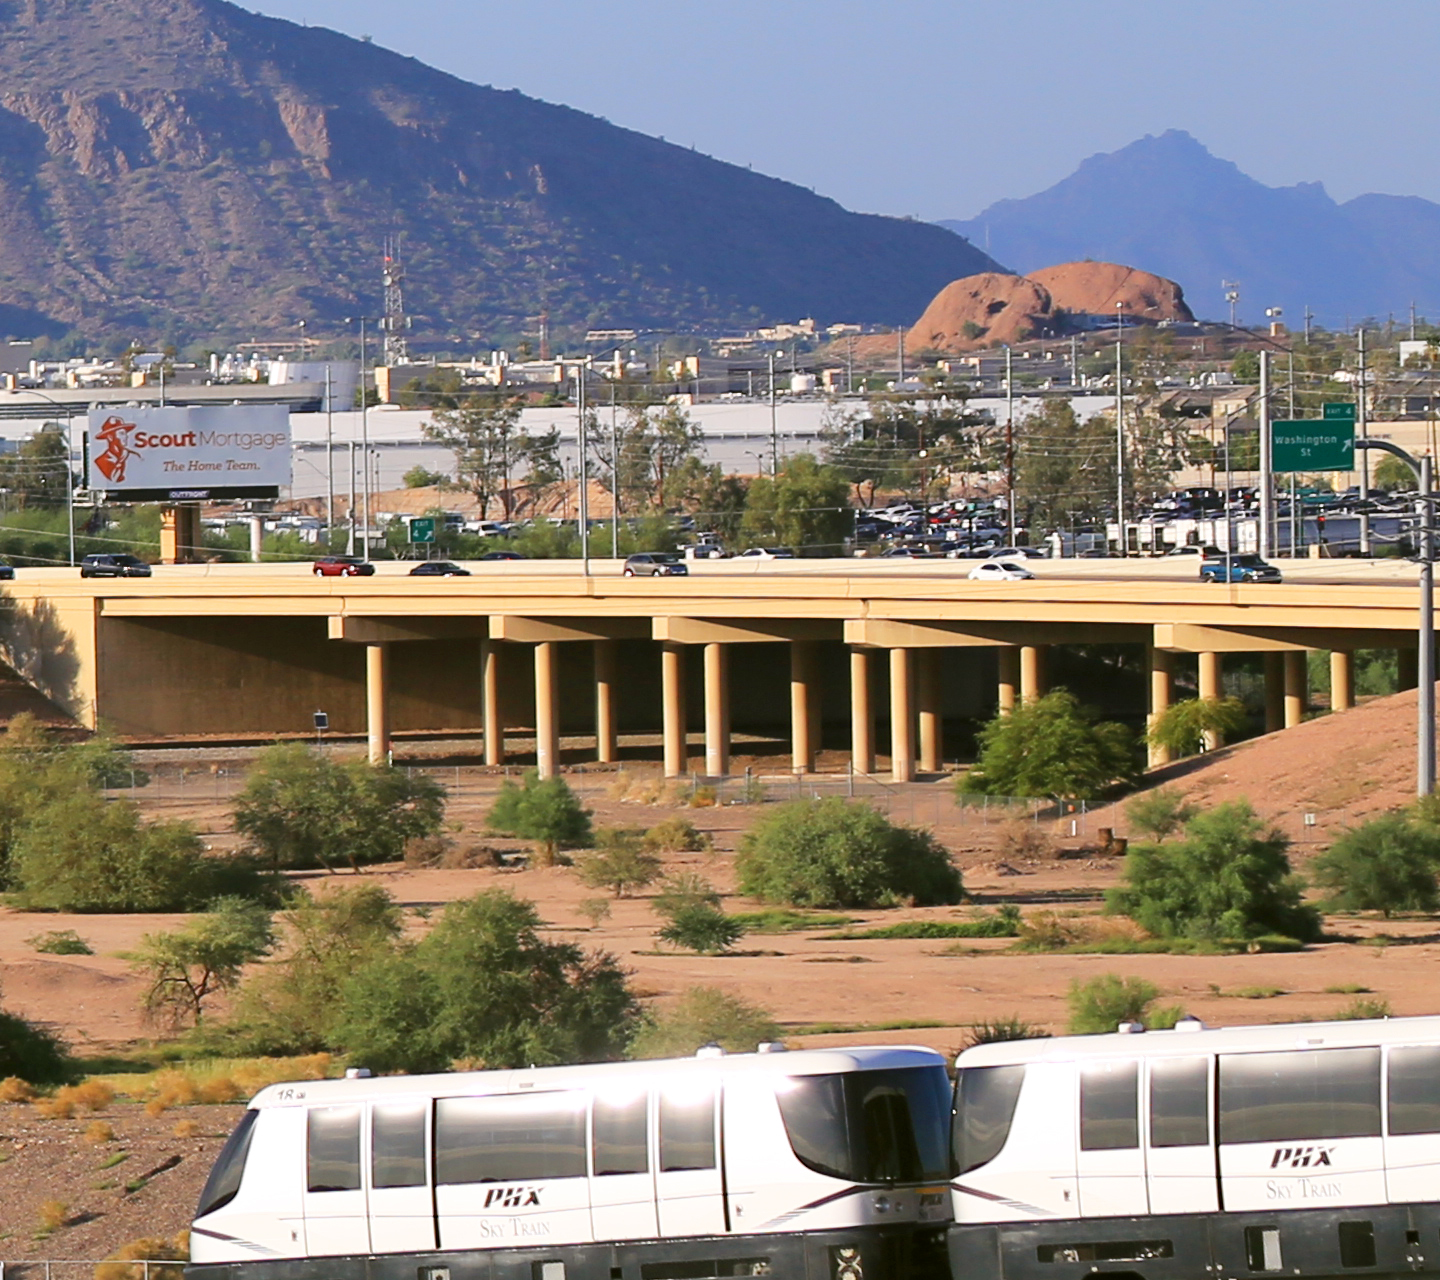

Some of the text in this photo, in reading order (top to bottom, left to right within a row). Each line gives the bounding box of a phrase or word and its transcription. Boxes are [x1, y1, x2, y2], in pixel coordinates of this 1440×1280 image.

[134, 431, 286, 450] Scout Mortgage
[1274, 435, 1338, 446] Washington
[1300, 448, 1311, 457] St
[163, 460, 260, 472] The Home Team.
[277, 1089, 295, 1100] 18
[1270, 1146, 1338, 1168] PHX
[483, 1186, 546, 1208] PHX
